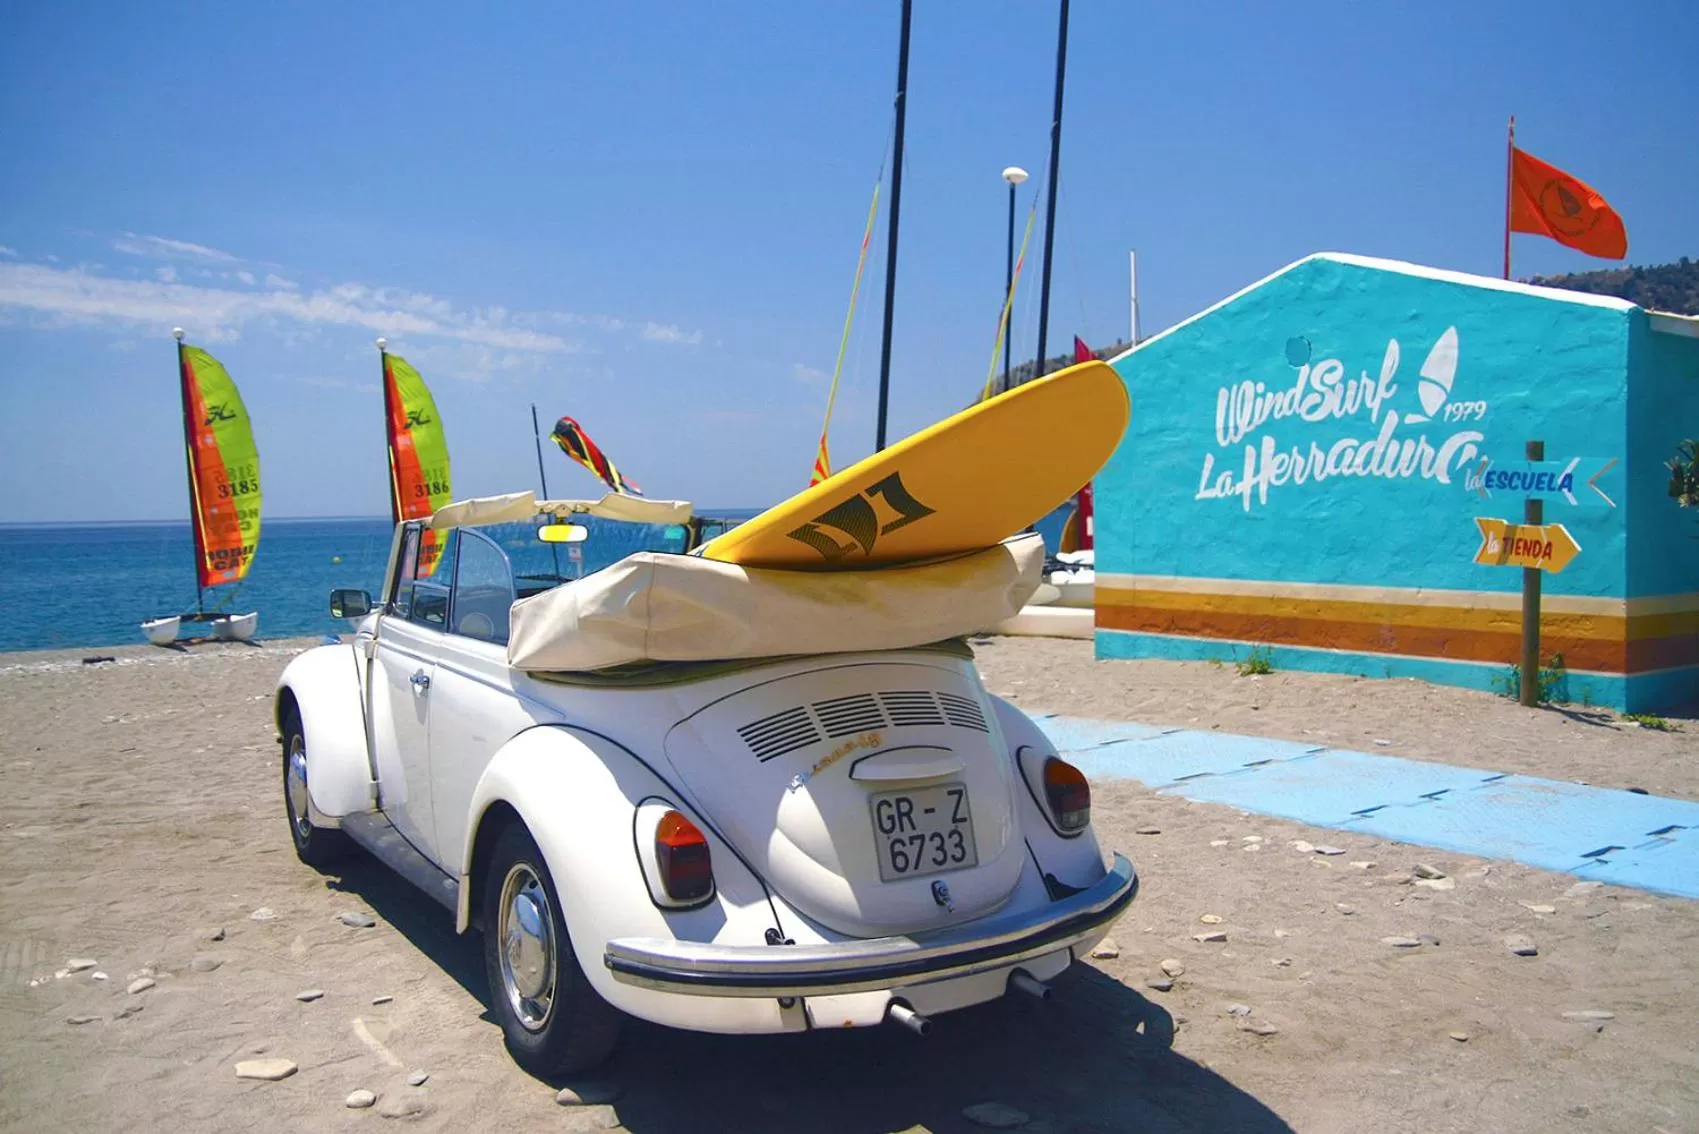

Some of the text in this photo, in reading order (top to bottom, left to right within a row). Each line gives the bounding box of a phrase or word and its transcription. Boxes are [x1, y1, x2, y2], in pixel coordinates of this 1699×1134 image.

[1443, 400, 1487, 422] 1979
[1195, 410, 1485, 512] La Herradura
[217, 478, 259, 499] 3185
[415, 481, 449, 498] 3186
[1484, 470, 1574, 493] ESCUELA
[1502, 536, 1553, 560] TIENDA
[876, 797, 916, 835] GR
[947, 789, 967, 824] Z
[889, 829, 967, 873] 6733
